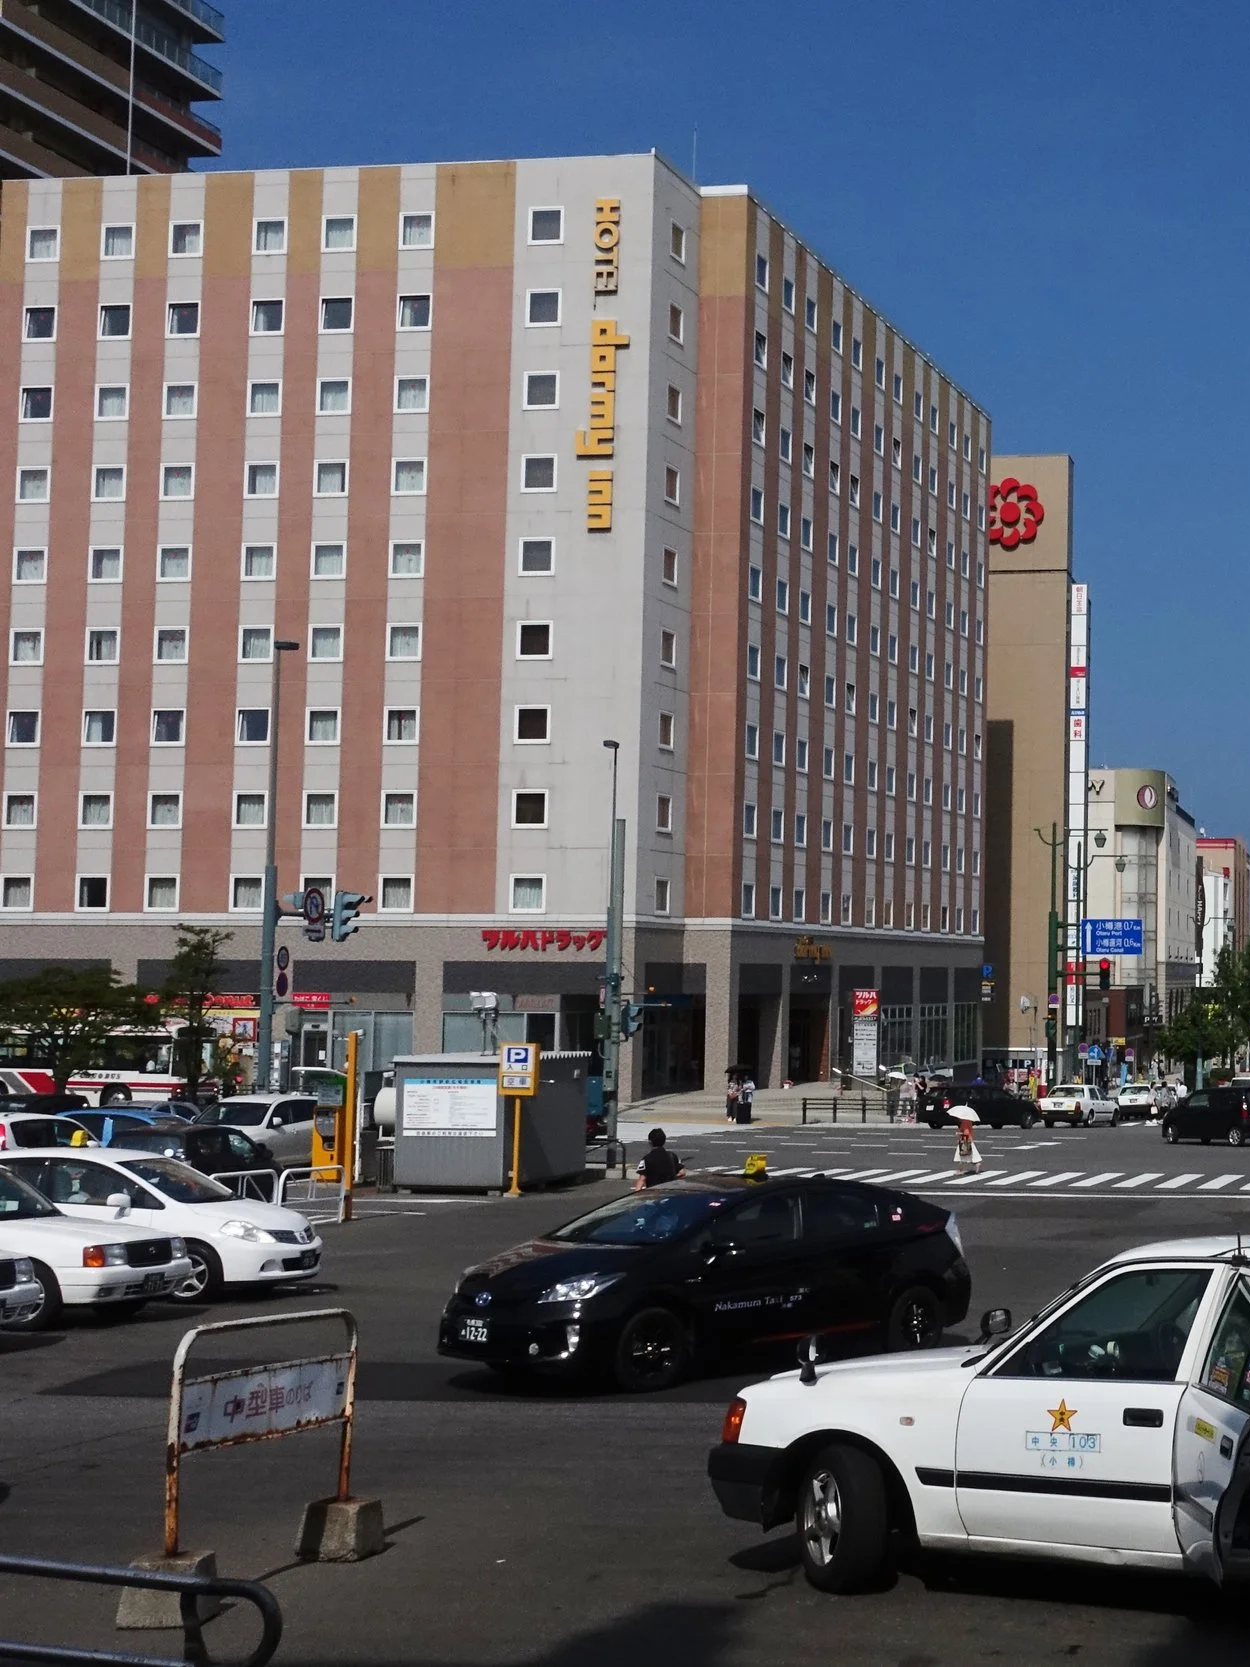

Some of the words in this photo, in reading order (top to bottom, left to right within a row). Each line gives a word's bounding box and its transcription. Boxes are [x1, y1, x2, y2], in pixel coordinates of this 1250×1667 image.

[594, 198, 621, 310] HOTEL
[576, 319, 630, 460] dormy
[587, 470, 613, 532] inn
[481, 929, 608, 951] ツルハドラッグ
[714, 1298, 762, 1312] Nakamura
[1031, 1436, 1058, 1447] 中央
[1071, 1436, 1096, 1449] 103
